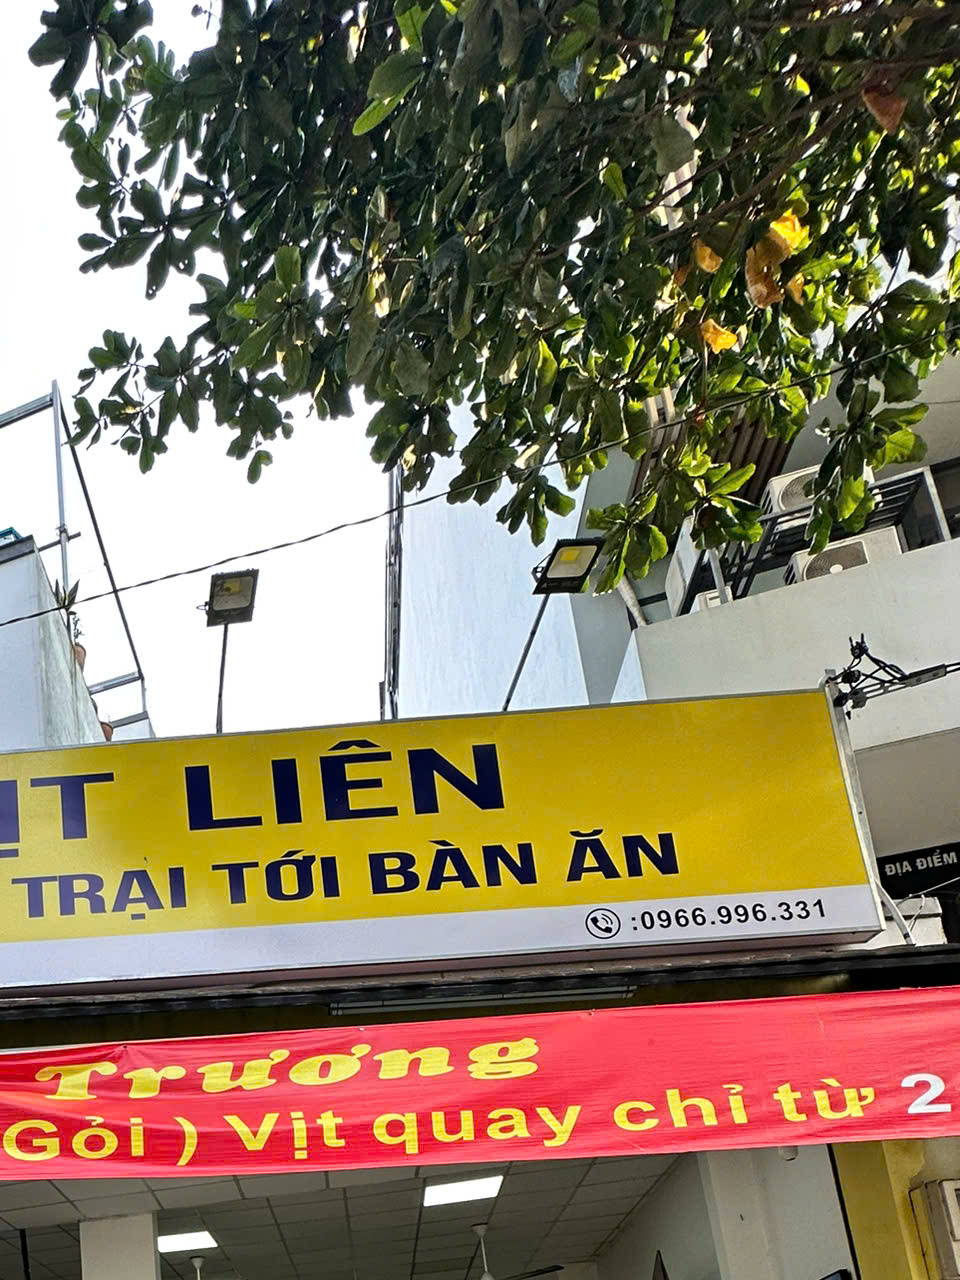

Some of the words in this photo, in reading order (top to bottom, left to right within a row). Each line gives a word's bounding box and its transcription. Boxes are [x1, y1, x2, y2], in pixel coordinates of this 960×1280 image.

[184, 739, 505, 832] LIÊN
[11, 867, 187, 921] TRẠI
[212, 848, 339, 905] TỚI
[367, 839, 538, 895] BÀN
[566, 828, 681, 882] ĂN
[885, 860, 913, 877] ĐỊA
[915, 849, 958, 870] ĐIỂM
[35, 1037, 541, 1101] Trương
[2, 1115, 144, 1161] Gỏi
[227, 1110, 345, 1161] Vịt
[373, 1105, 583, 1155] quay
[613, 1084, 748, 1130] chỉ
[772, 1077, 876, 1122] từ
